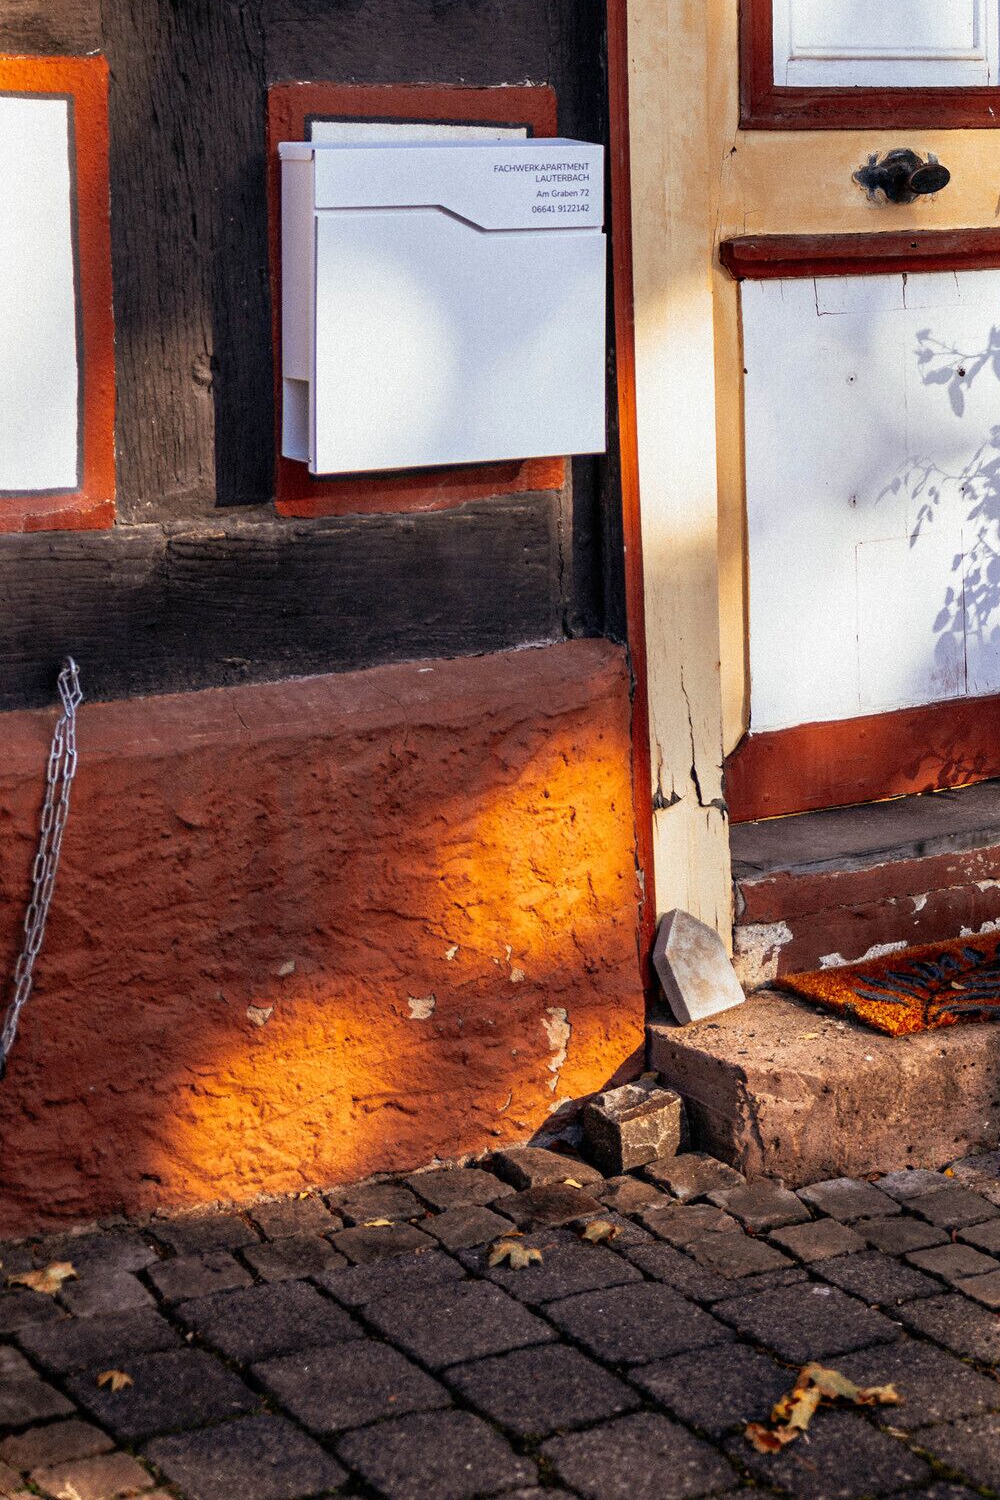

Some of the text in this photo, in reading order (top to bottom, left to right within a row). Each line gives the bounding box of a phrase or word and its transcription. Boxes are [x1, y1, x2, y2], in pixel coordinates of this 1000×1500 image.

[494, 163, 589, 172] FACHWERKAPARTMENT
[535, 174, 589, 183] LAUTERBACH
[536, 189, 589, 198] Am Graben 72
[531, 204, 589, 213] 06641 9122142
